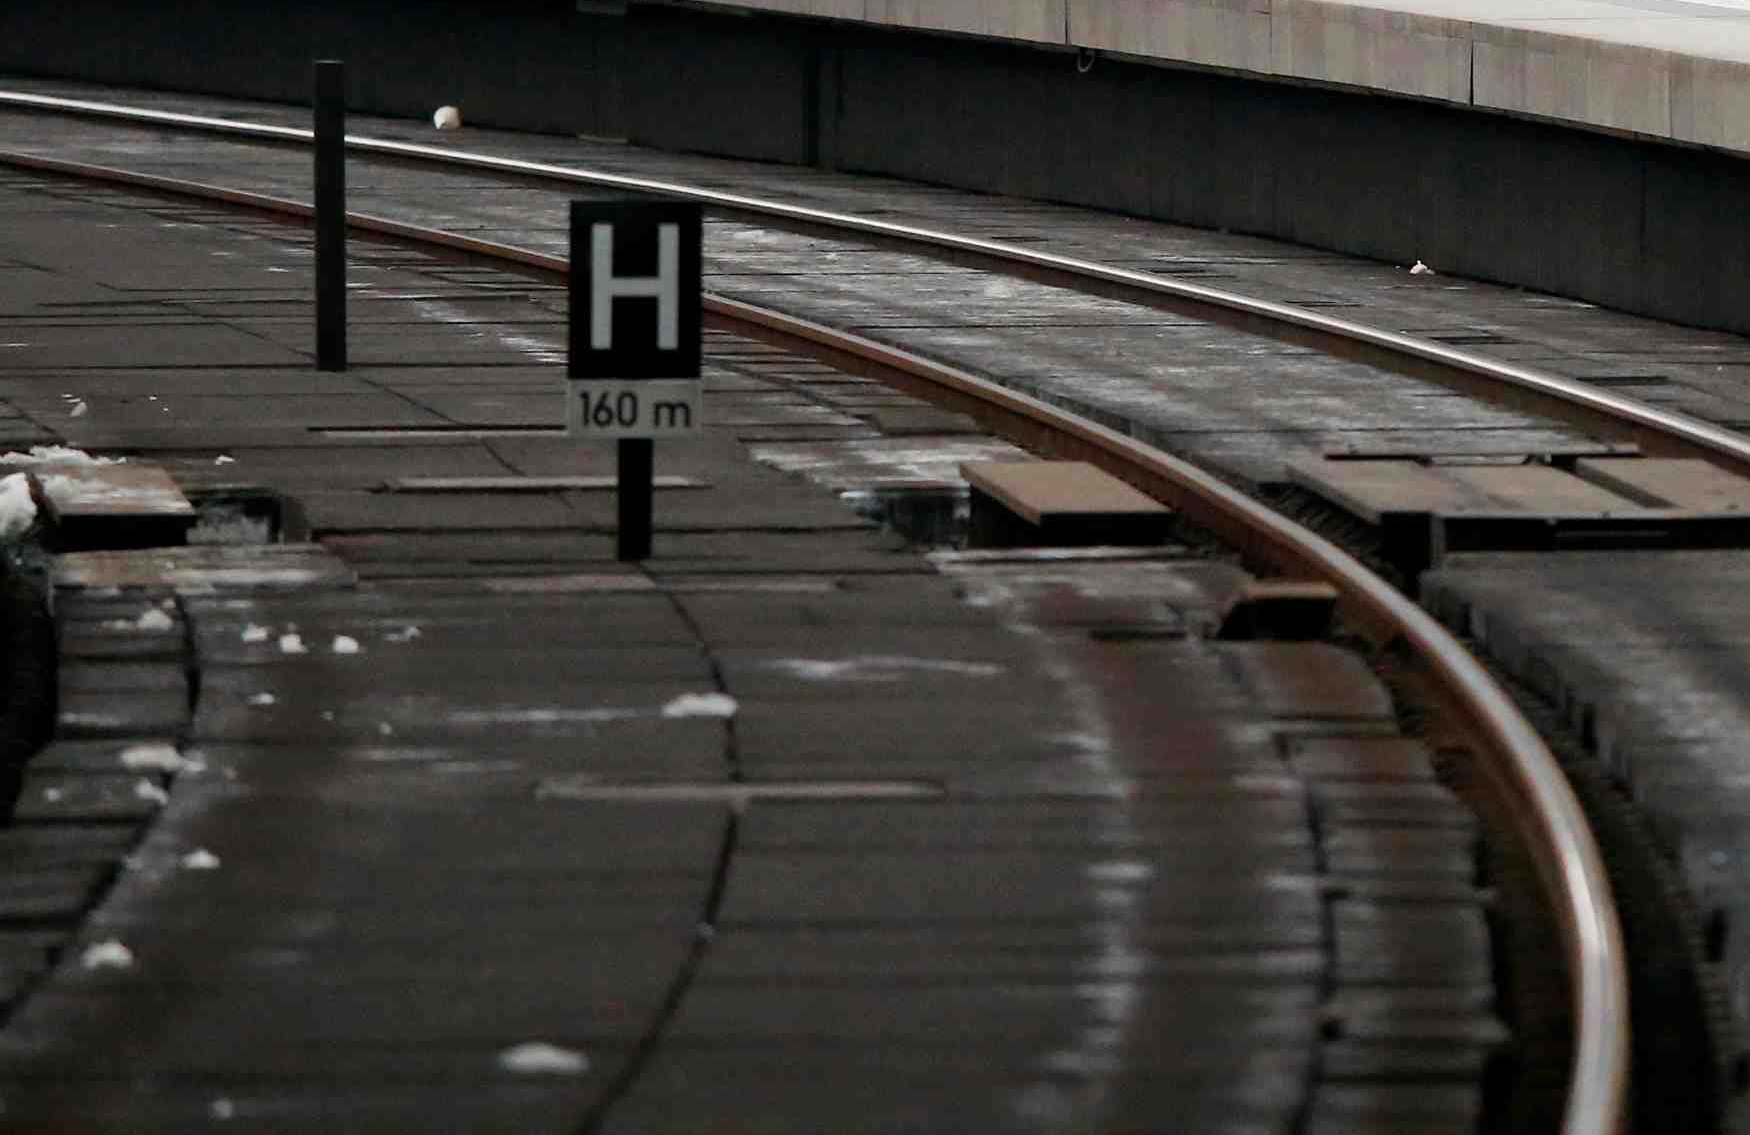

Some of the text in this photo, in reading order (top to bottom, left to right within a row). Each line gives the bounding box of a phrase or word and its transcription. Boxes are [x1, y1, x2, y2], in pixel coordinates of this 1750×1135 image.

[590, 222, 680, 351] H
[579, 390, 692, 428] 160 m
